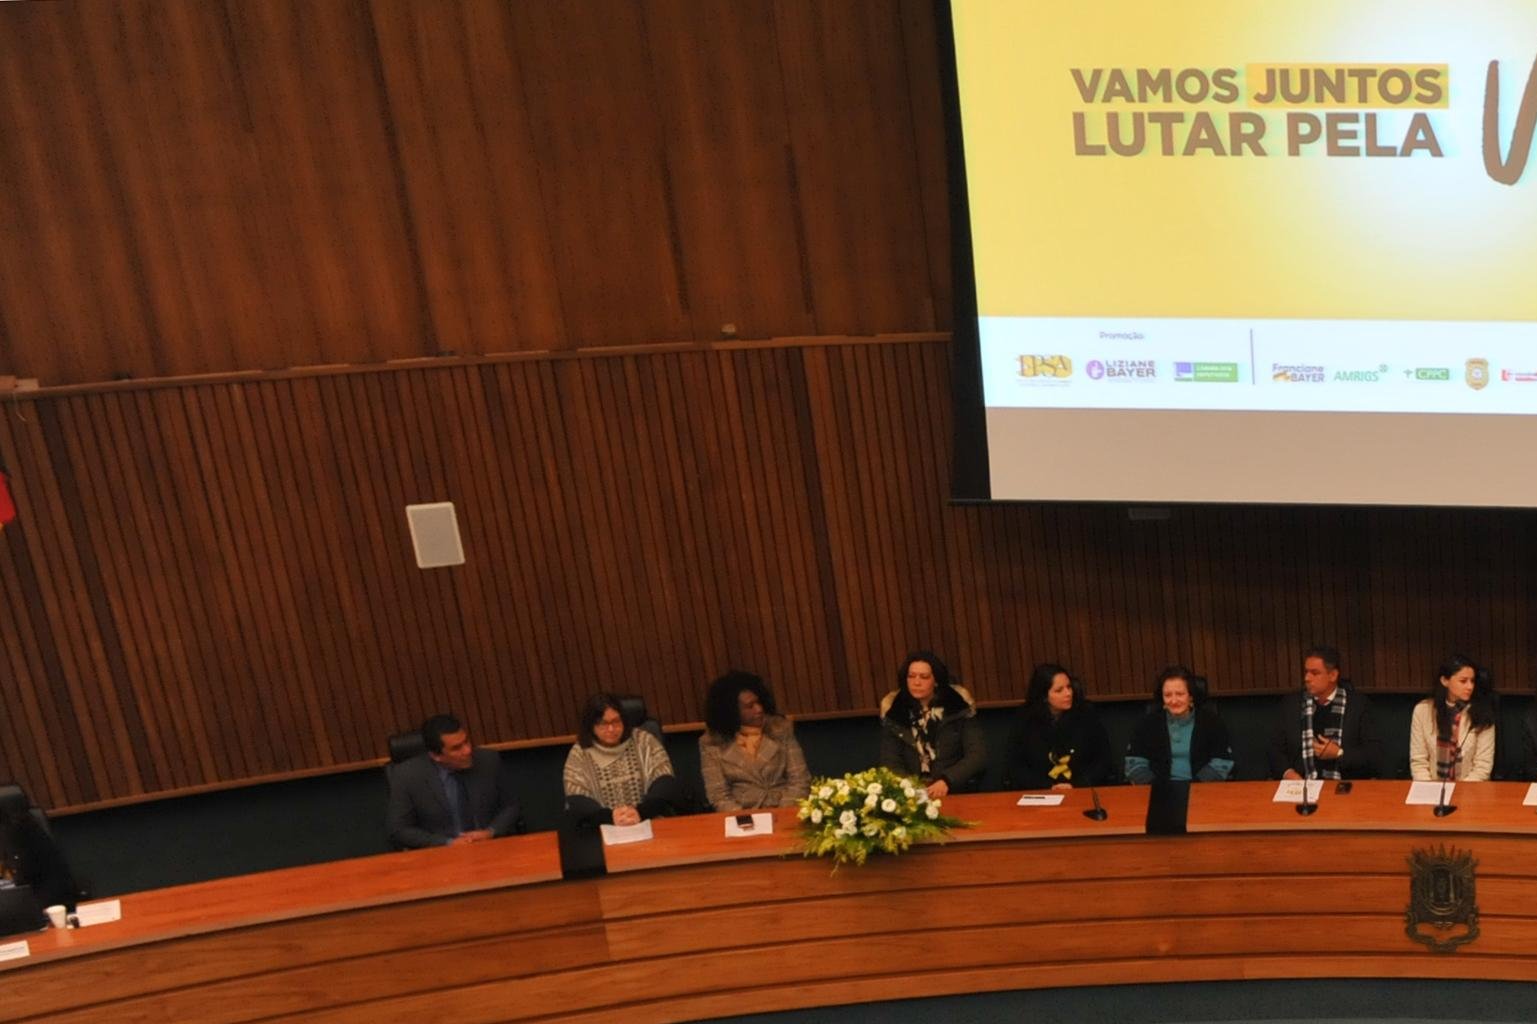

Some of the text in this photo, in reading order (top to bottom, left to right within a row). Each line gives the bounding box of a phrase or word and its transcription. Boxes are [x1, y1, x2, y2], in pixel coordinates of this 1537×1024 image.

[1070, 67, 1443, 104] VAMOS JUNTOS
[1072, 113, 1444, 157] LUTAR PELA
[1105, 360, 1156, 368] LIZIANE
[1106, 367, 1157, 378] BAYER
[1290, 373, 1326, 382] BAYER
[1333, 371, 1380, 382] AMRIGS
